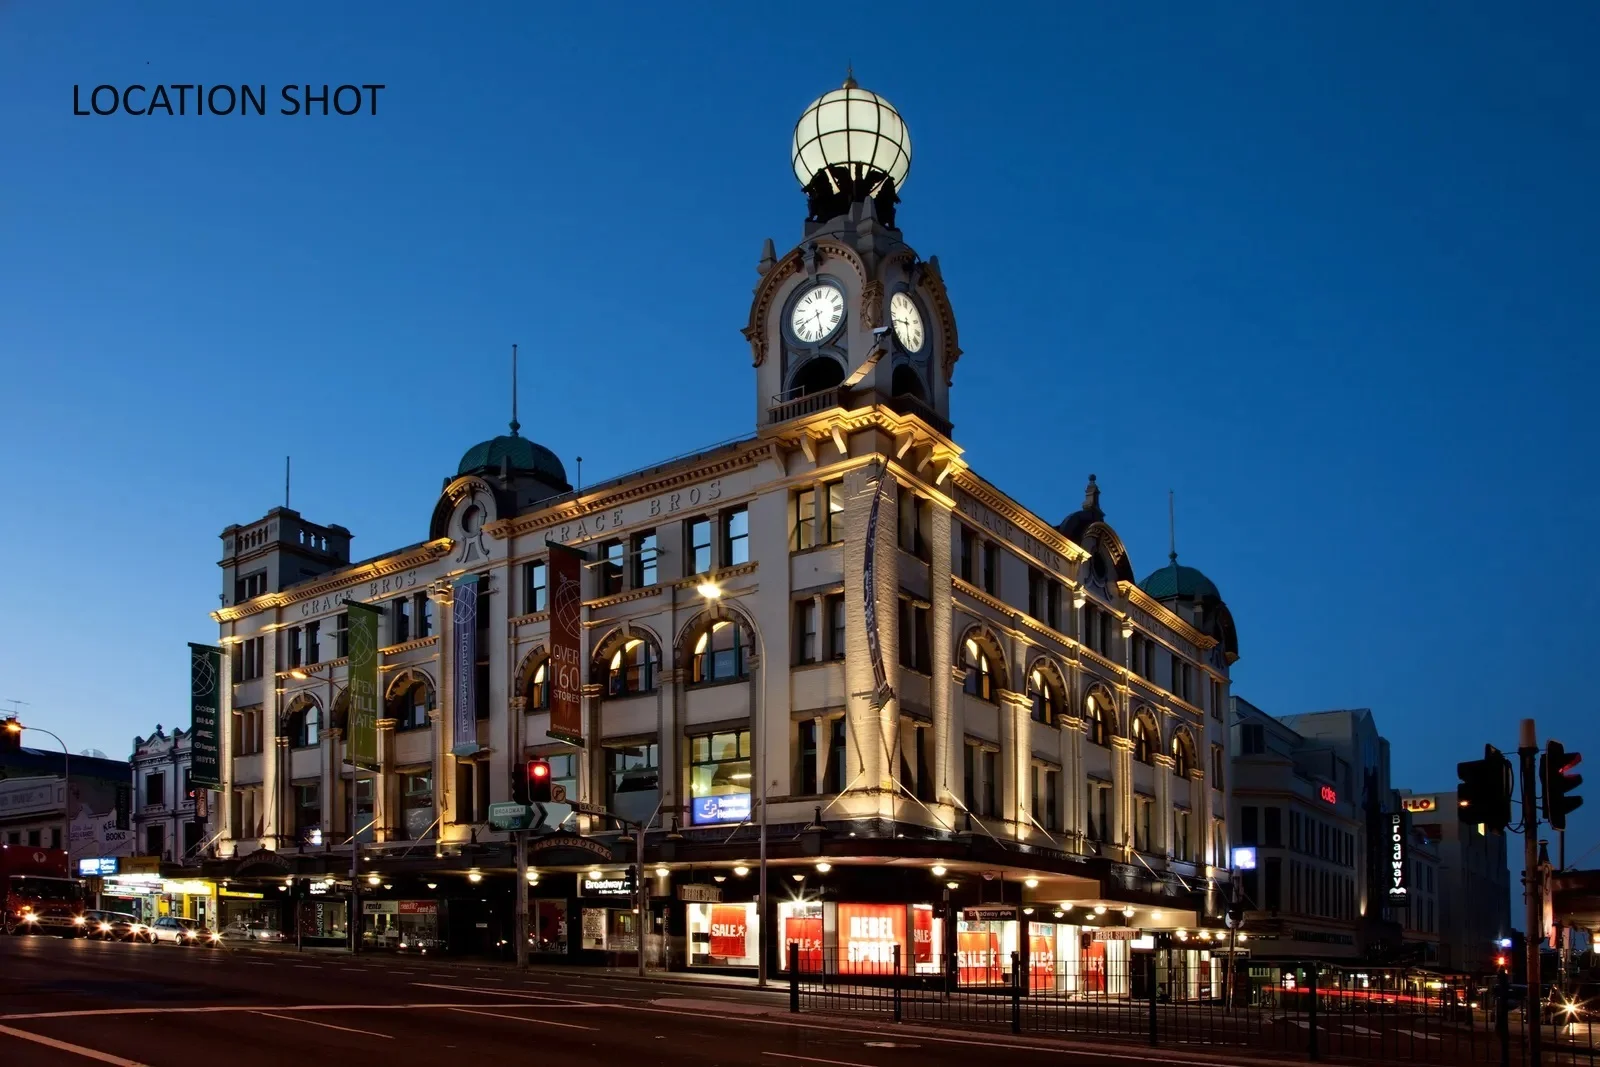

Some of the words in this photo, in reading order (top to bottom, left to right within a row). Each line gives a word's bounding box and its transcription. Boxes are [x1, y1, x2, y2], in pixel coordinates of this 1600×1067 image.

[545, 509, 623, 543] GRACE
[648, 480, 722, 517] BROS
[301, 590, 354, 617] GRACE
[369, 572, 417, 596] BROS
[553, 644, 580, 665] OVER
[553, 662, 579, 691] 160
[553, 689, 580, 703] STORES
[494, 807, 525, 815] BROADWAY
[580, 804, 594, 812] BAY
[106, 831, 126, 841] BOOKS
[1391, 814, 1403, 887] Broadway
[586, 880, 623, 890] Broadway
[712, 923, 736, 937] SALE
[850, 916, 894, 939] REBEL
[914, 929, 929, 943] SALE
[1095, 931, 1113, 940] REBEL
[1115, 931, 1136, 940] SPORT
[958, 950, 987, 967] SALE
[1029, 951, 1047, 967] ALE
